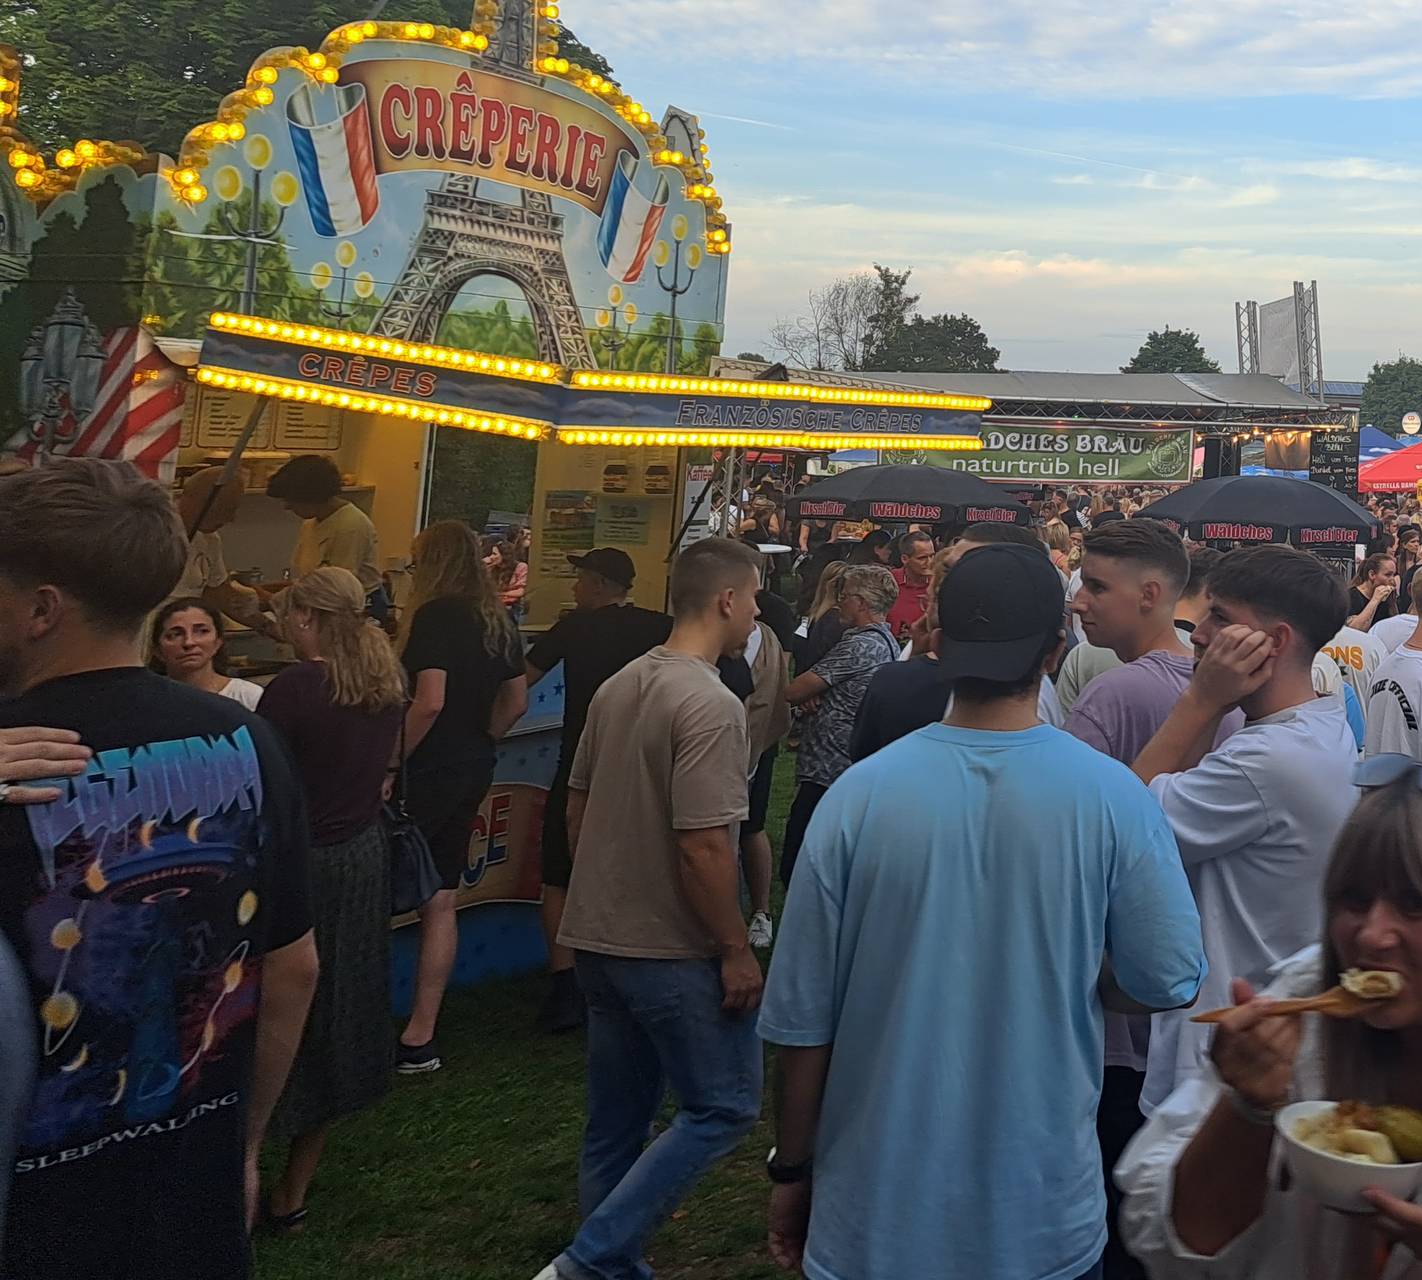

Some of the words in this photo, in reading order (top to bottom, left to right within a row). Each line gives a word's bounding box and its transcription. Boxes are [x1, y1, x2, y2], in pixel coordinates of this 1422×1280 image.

[379, 70, 607, 201] CRÊPERIE
[298, 353, 437, 397] CRÊPES
[675, 399, 843, 430] FRANZÖSISCHE
[1075, 433, 1144, 453] BRÄU
[953, 457, 1070, 475] naturtrüb
[1079, 458, 1119, 476] hell
[872, 503, 941, 519] Wäldches
[1204, 523, 1273, 541] Wäldches
[15, 1091, 239, 1173] SLEEPWALING
